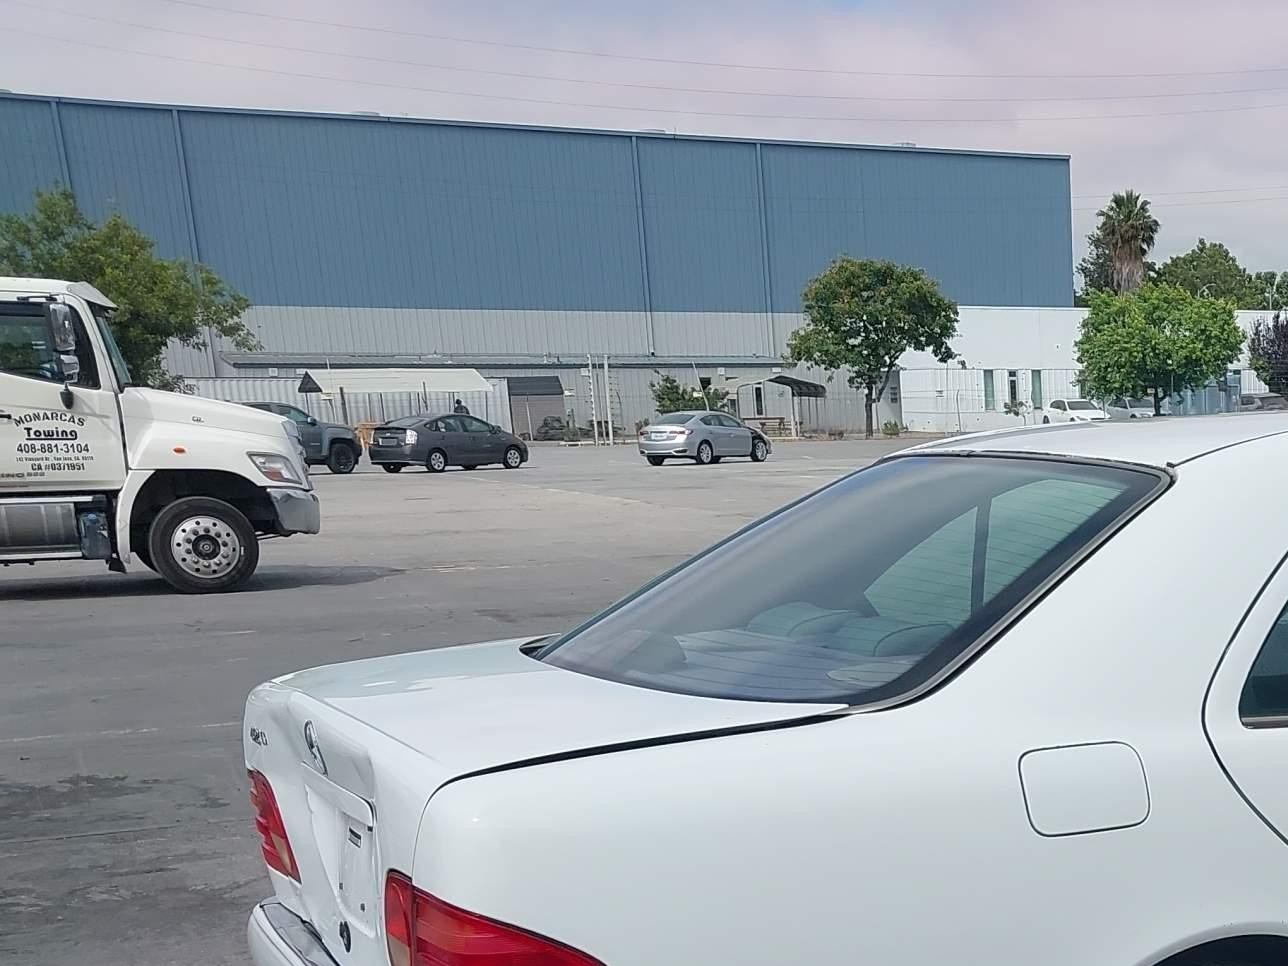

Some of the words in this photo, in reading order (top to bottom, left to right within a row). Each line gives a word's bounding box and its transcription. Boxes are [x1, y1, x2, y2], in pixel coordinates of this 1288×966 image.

[13, 411, 86, 427] MONARCAS
[23, 426, 78, 441] Towing
[16, 443, 90, 454] 408-881-3104
[31, 463, 43, 471] CA
